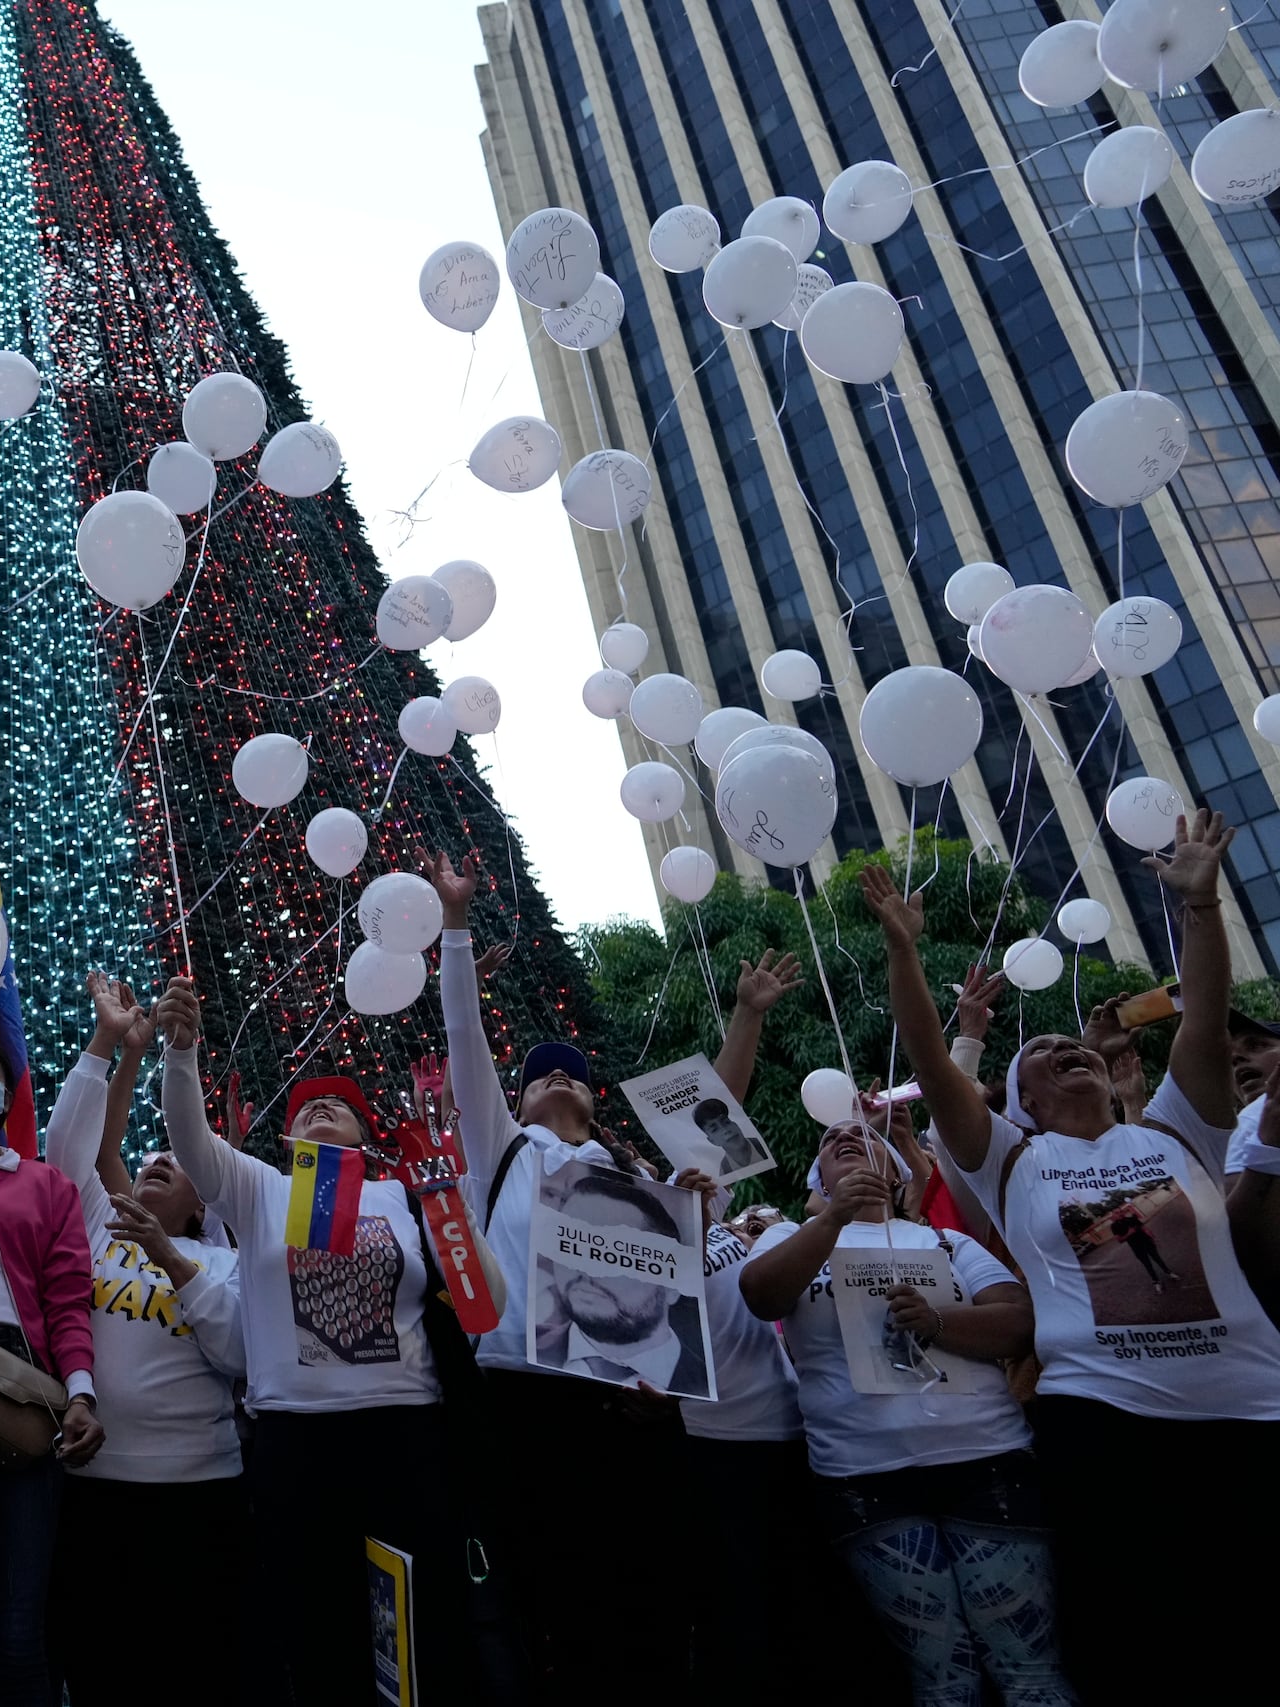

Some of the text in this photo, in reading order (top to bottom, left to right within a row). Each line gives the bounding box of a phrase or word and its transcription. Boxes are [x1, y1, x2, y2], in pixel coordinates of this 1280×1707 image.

[669, 1069, 701, 1086] LIBERTAD
[645, 1076, 700, 1103] INMEDIATA PARA
[652, 1084, 701, 1109] JEANDER
[661, 1095, 701, 1116] GARCÍA
[1041, 1167, 1096, 1182] Libertad
[1100, 1164, 1131, 1180] para
[1062, 1167, 1167, 1191] Enrique Arrieta
[557, 1225, 677, 1265] JULIO, CIERRA
[560, 1240, 675, 1280] EL RODEO I
[845, 1277, 936, 1288] LUIS MIELES
[903, 1269, 928, 1277] PARA
[1095, 1324, 1228, 1347] Soy inocente, no
[1113, 1341, 1221, 1361] soy terrorista
